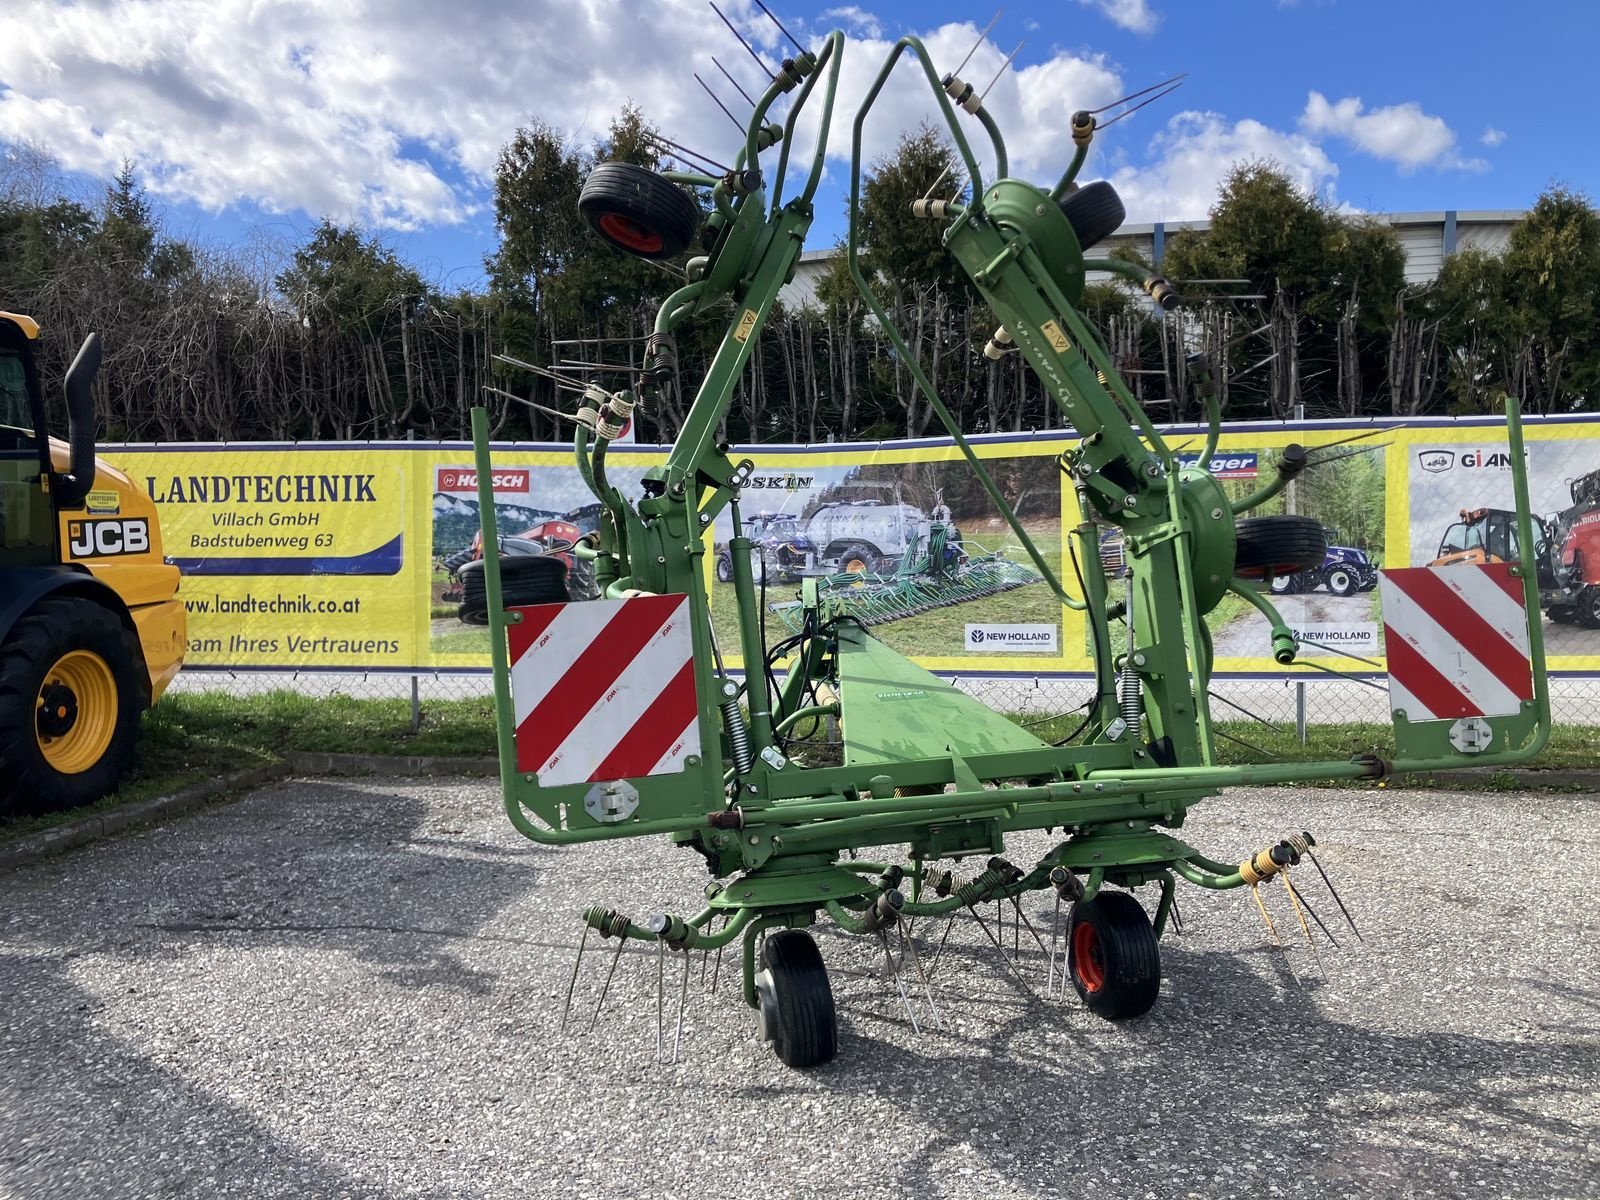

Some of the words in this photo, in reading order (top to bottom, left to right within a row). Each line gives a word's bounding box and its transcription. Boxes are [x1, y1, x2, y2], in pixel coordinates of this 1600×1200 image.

[1461, 449, 1528, 468] GiAN
[146, 474, 377, 504] LANDTECHNIK
[456, 474, 525, 487] HOSCH
[212, 513, 263, 527] Villach
[268, 512, 320, 527] GmbH
[71, 520, 148, 556] JCB
[190, 534, 309, 550] Badstubenweg
[314, 533, 334, 547] 63
[185, 594, 360, 613] ww.landtechnik.co.at
[230, 635, 279, 652] Ihres
[287, 635, 400, 653] Vertrauens
[986, 632, 1007, 641] NEW
[1008, 632, 1050, 641] HOLLAND
[1302, 632, 1324, 640] NEW
[1325, 631, 1371, 640] HOLLAND
